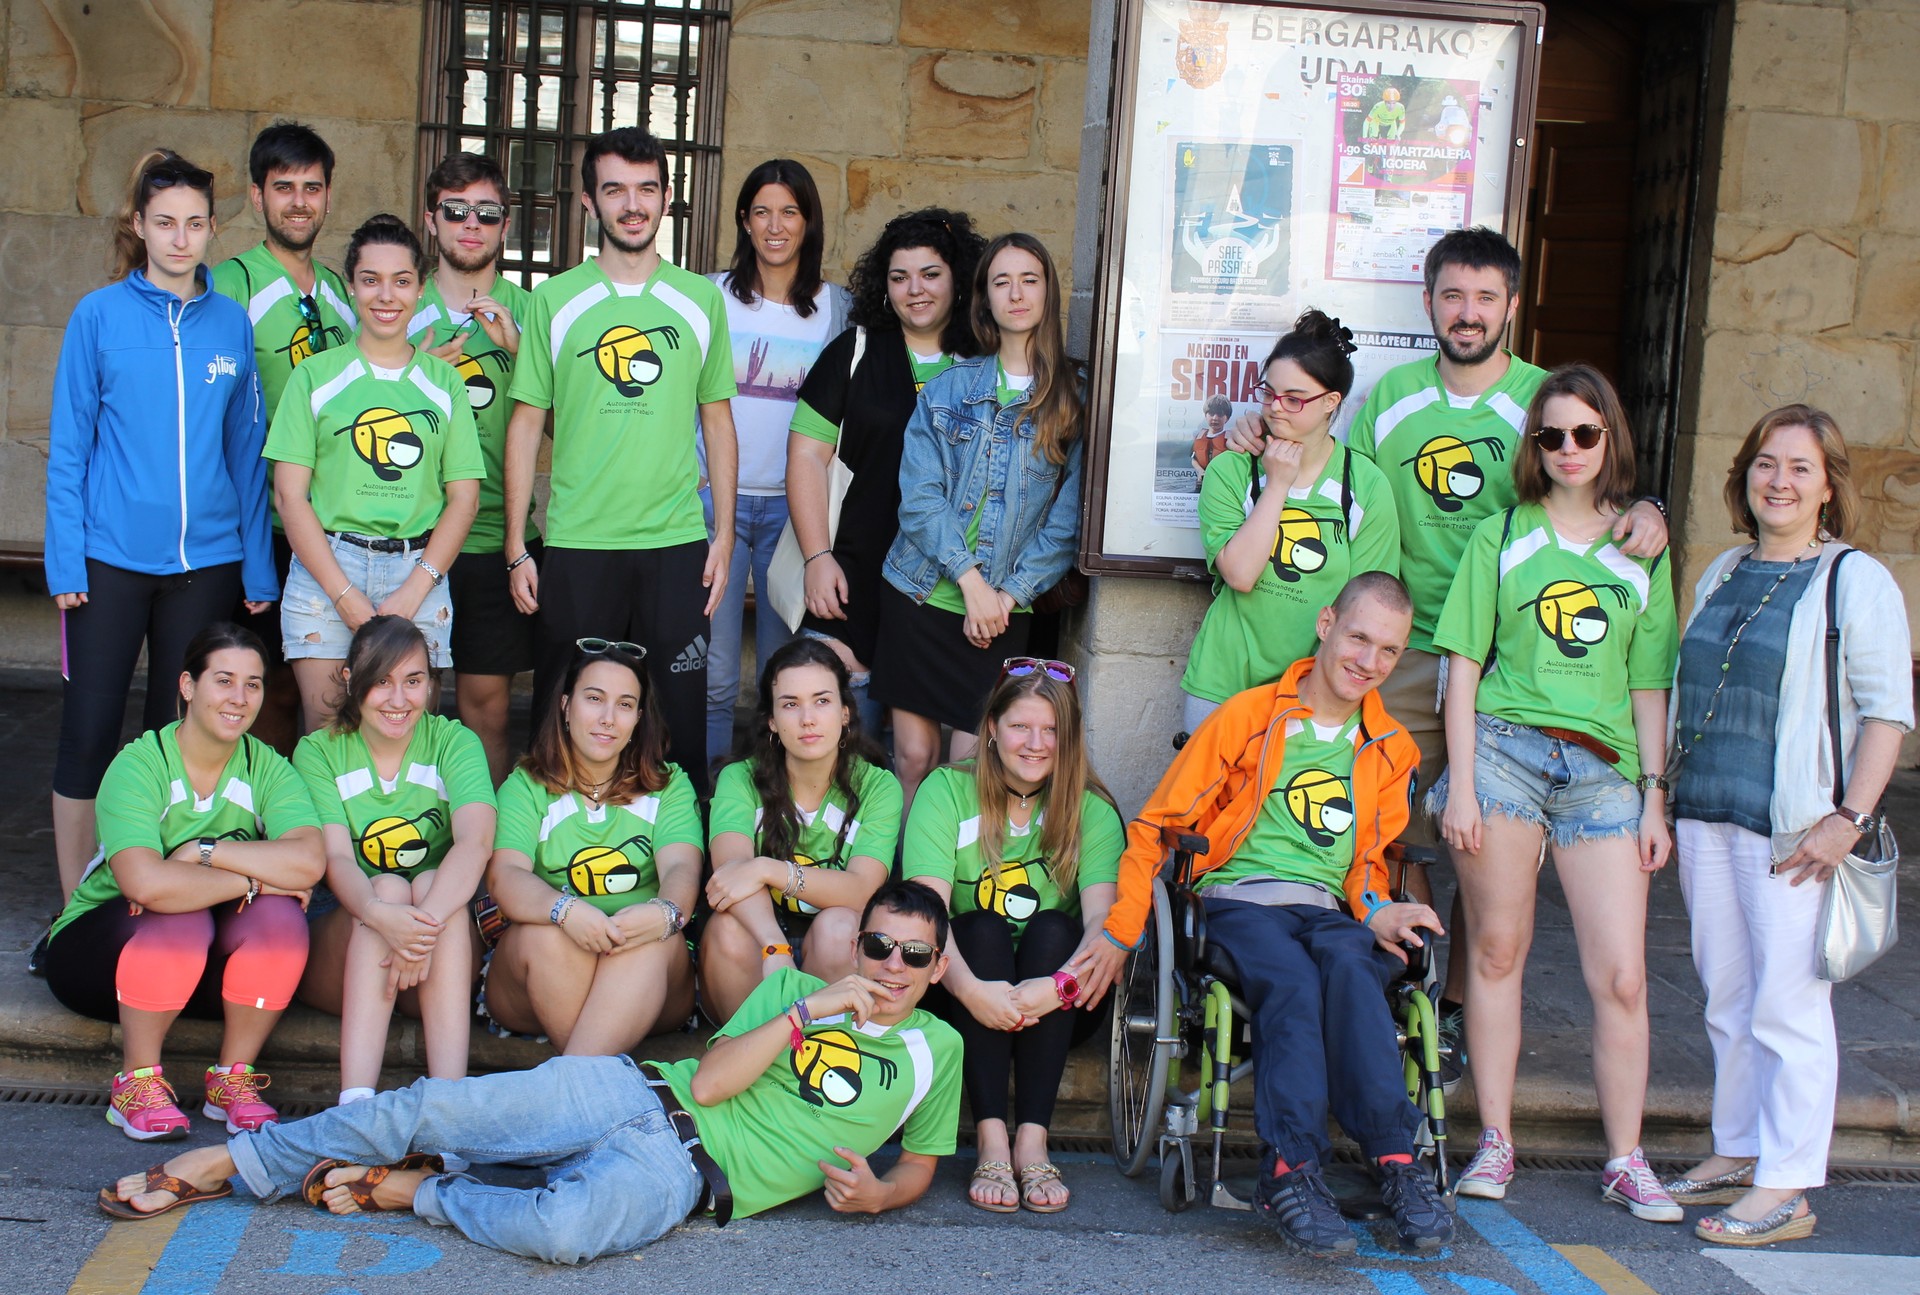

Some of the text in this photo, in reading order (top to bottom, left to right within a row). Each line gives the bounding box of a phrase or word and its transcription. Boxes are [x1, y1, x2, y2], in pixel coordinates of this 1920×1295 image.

[1251, 13, 1475, 58] BERGARAKO
[1340, 75, 1375, 84] Ekainak
[1340, 84, 1362, 97] 30
[1338, 143, 1472, 160] 1.go SAN MARTZIALERA
[1382, 159, 1427, 170] IGOERA
[1219, 246, 1242, 260] SAFE
[1208, 260, 1252, 275] PASSAGE
[1187, 343, 1248, 360] NACIDO EN
[1171, 358, 1260, 403] SIRIA
[355, 489, 379, 497] Campos
[1537, 666, 1562, 674] Campos
